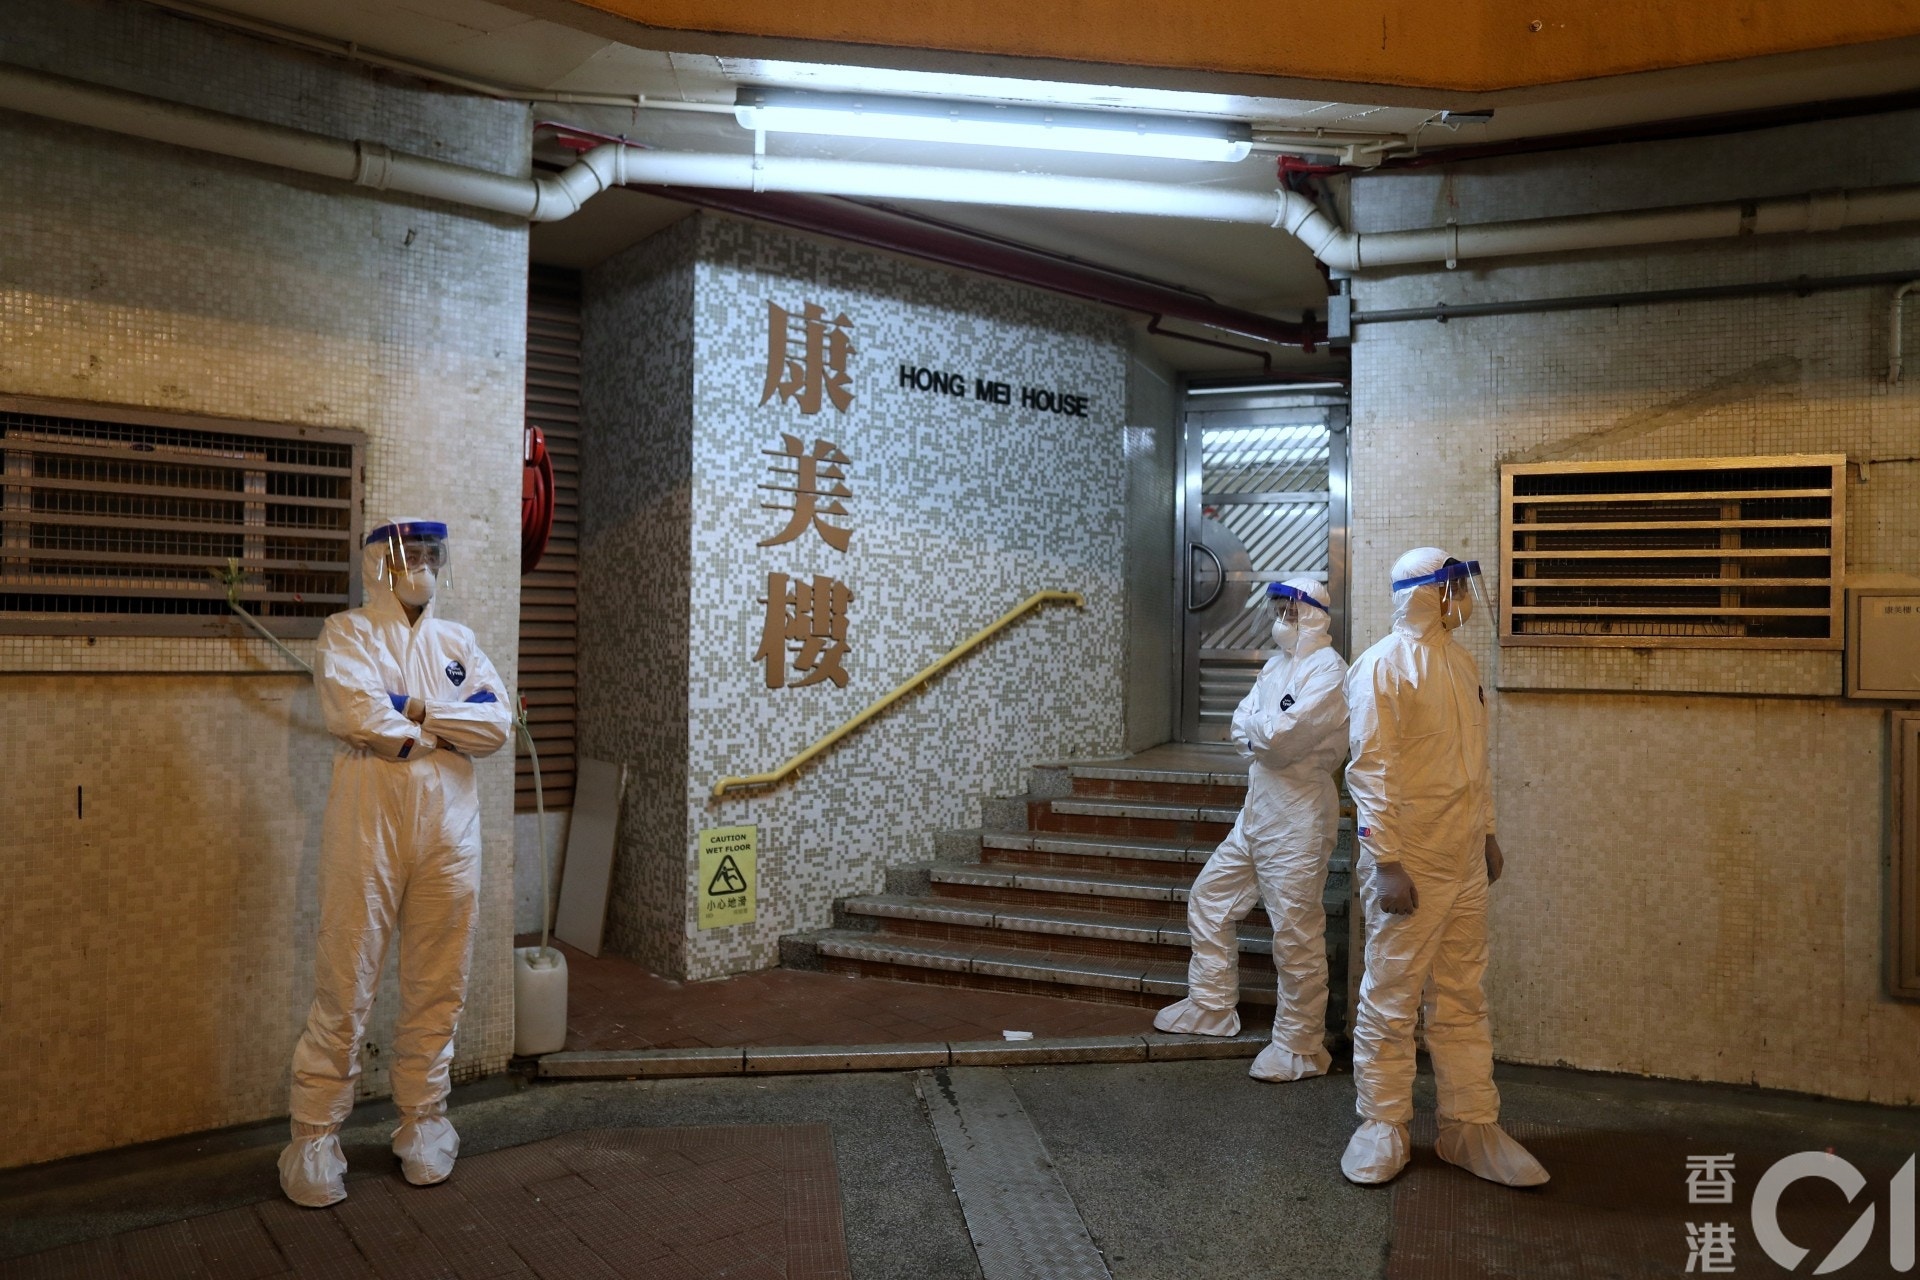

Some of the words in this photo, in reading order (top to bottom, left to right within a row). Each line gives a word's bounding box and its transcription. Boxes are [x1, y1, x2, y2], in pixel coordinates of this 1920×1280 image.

[900, 365, 965, 397] HONG
[976, 379, 1011, 405] MEI
[1022, 386, 1088, 417] HOUSE
[753, 300, 856, 689] 康美樓
[710, 834, 747, 843] CAUTION
[725, 844, 751, 852] FLOOR
[706, 896, 746, 911] 小心地滑
